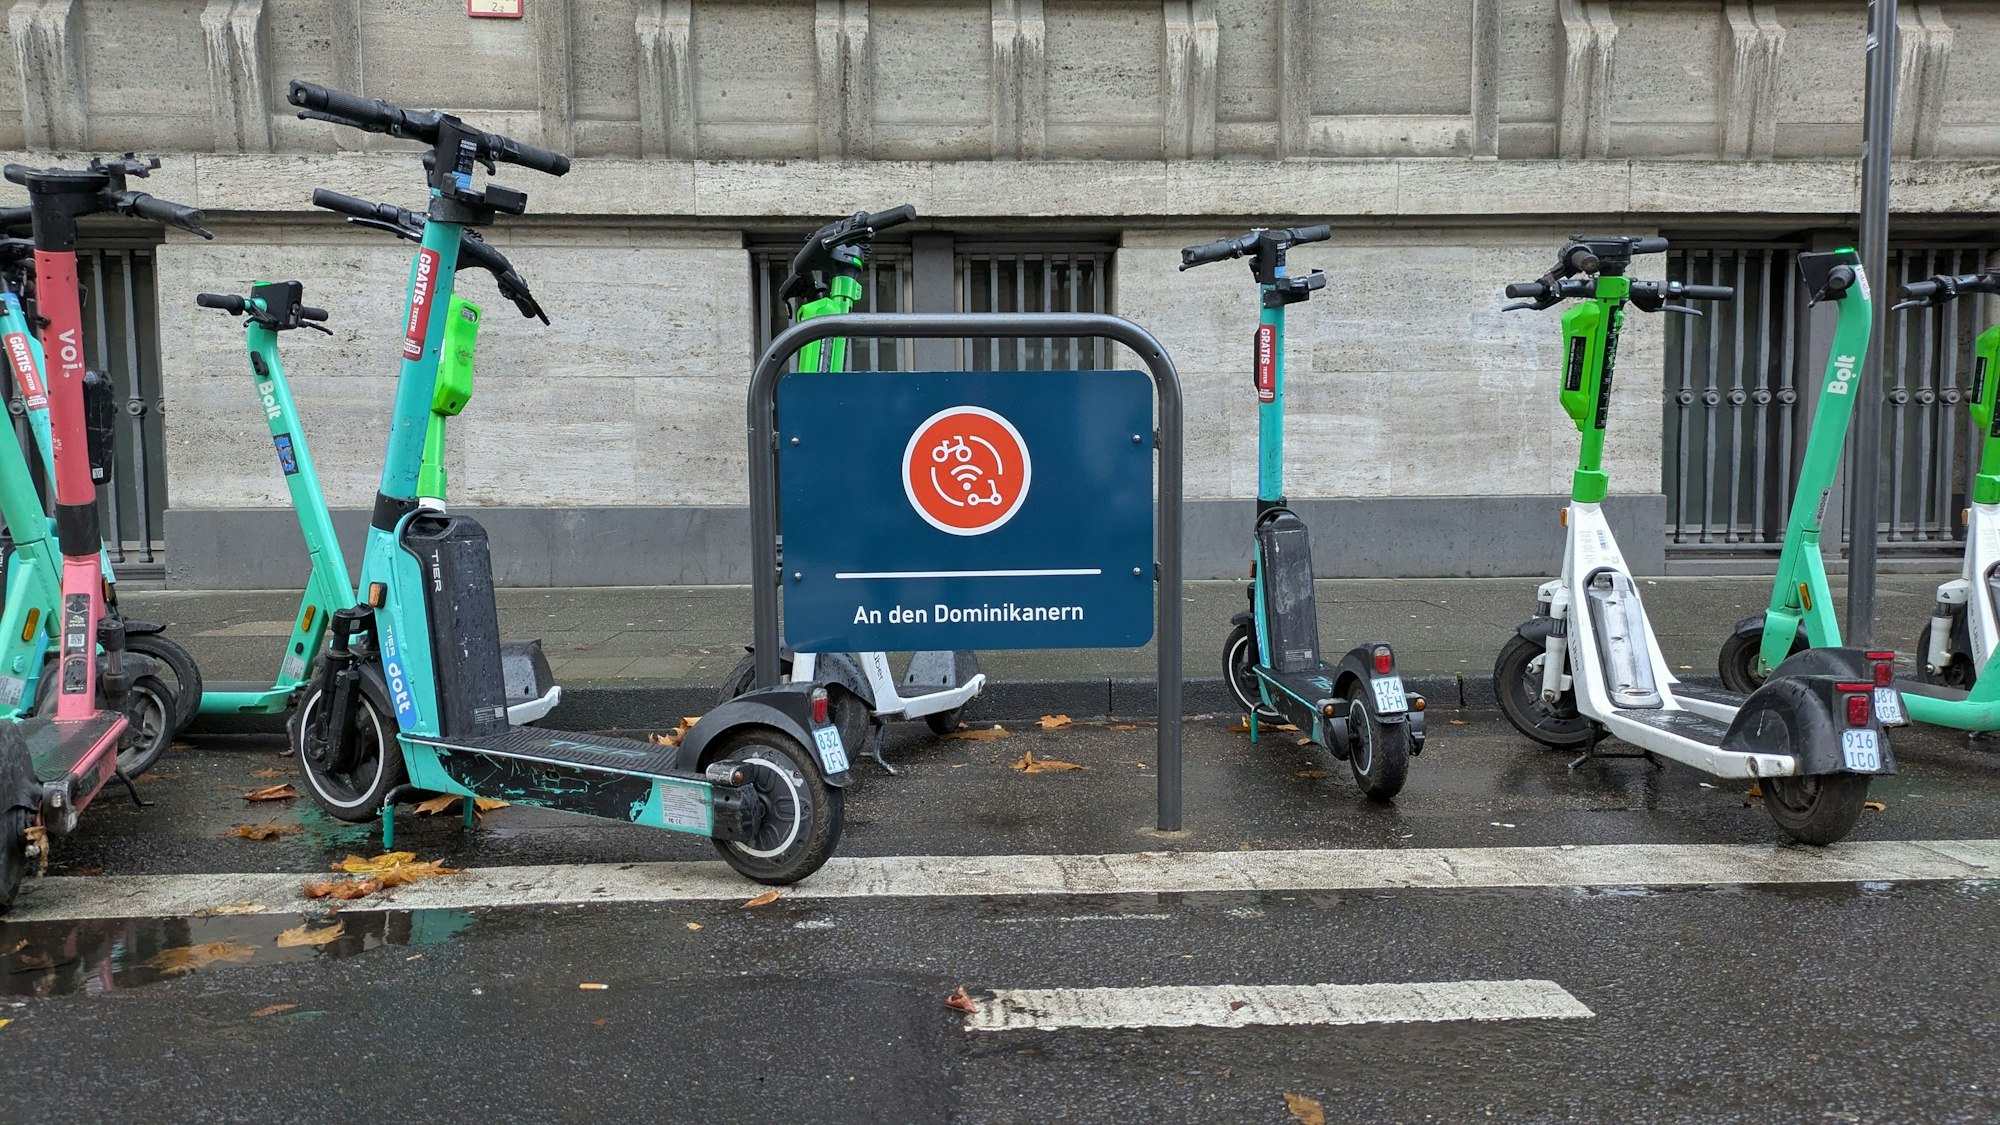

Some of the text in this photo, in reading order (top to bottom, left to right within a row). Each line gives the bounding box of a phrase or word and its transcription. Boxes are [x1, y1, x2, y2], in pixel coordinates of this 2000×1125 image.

[414, 253, 433, 307] GRATIS
[11, 335, 33, 373] GRATIS
[1260, 328, 1271, 365] GRATIS
[1827, 354, 1857, 395] Bolt
[258, 381, 281, 419] Bolt
[430, 549, 443, 593] TIER
[853, 603, 1084, 625] An den Dominikanern
[386, 624, 412, 715] TIER dott
[1376, 680, 1400, 695] 174
[1381, 695, 1404, 711] IFH
[817, 731, 839, 750] 832
[1846, 732, 1874, 749] 916
